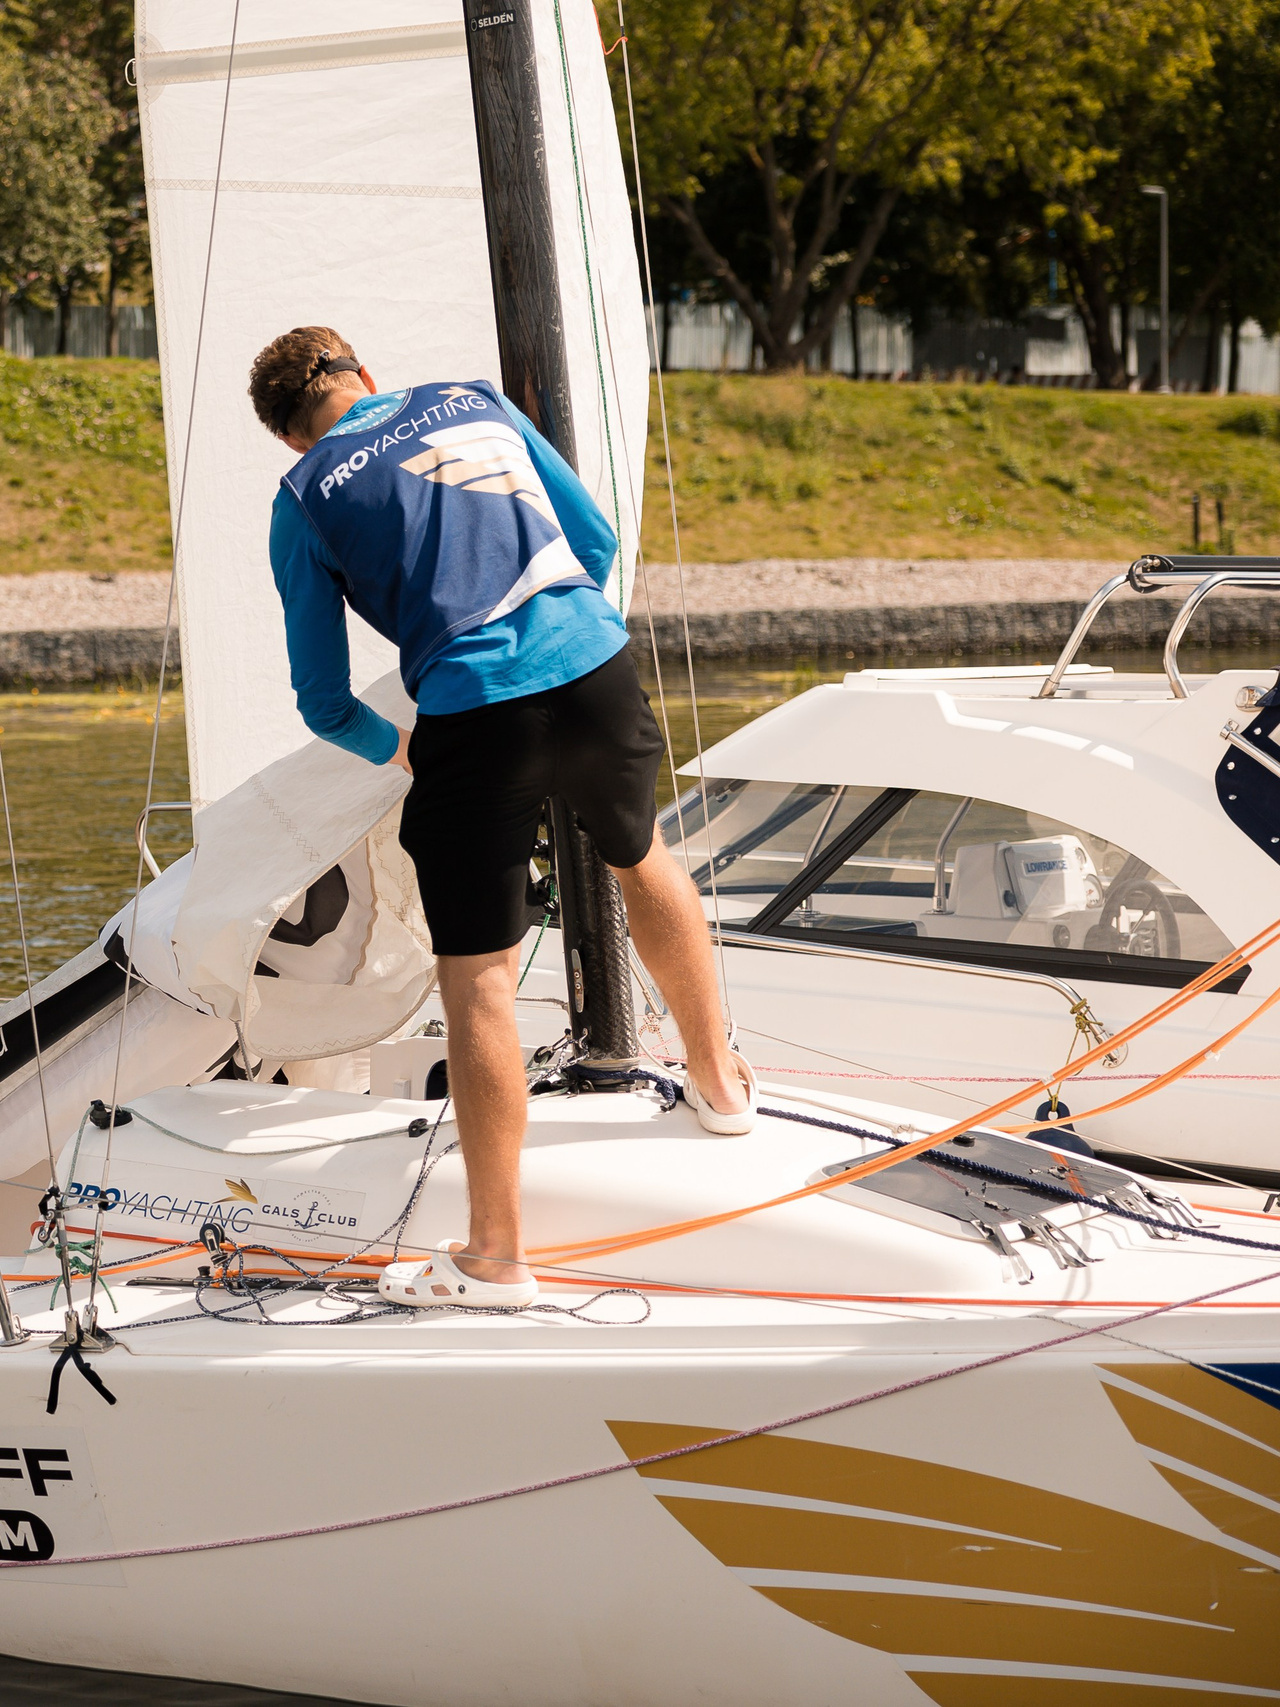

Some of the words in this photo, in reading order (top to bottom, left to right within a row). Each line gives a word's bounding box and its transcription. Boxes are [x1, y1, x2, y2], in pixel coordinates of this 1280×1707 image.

[478, 13, 514, 28] SELDÉN
[320, 396, 488, 500] PROYACHTING
[1026, 861, 1067, 873] LOWRANCE
[67, 1182, 254, 1233] PROYACHTING
[261, 1203, 301, 1219] GALS
[317, 1212, 358, 1228] CLUB
